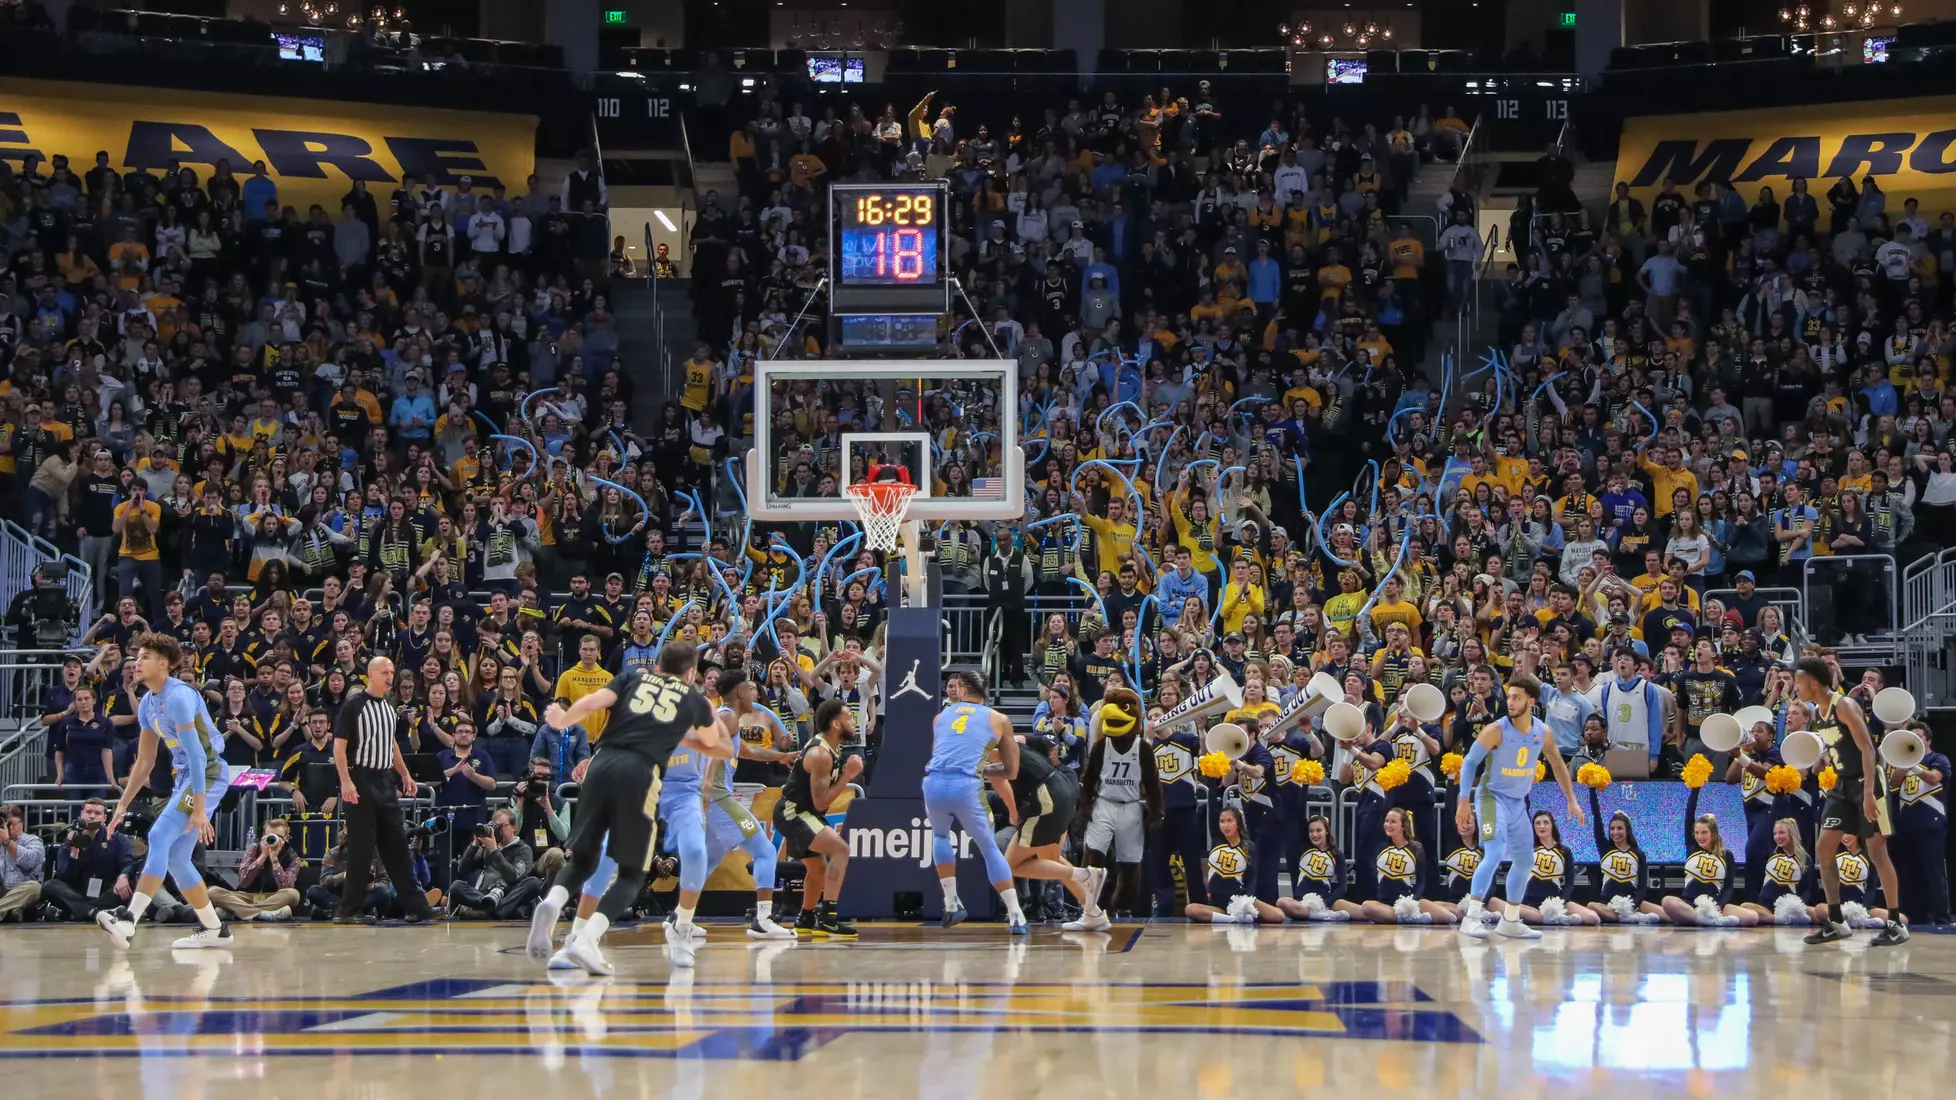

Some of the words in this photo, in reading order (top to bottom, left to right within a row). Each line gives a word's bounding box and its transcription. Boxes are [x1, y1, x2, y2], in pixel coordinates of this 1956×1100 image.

[610, 11, 623, 22] EXIT
[598, 97, 621, 118] 110
[647, 97, 670, 118] 112
[1496, 99, 1520, 119] 112
[1545, 99, 1569, 119] 113
[123, 120, 503, 189] ARE
[856, 195, 933, 226] 16:29
[877, 228, 924, 280] 18
[1051, 299, 1061, 310] 3
[1807, 320, 1821, 331] 33
[691, 372, 704, 383] 33
[467, 550, 476, 563] 3
[628, 682, 683, 723] 55
[1188, 683, 1214, 708] OUT
[1291, 687, 1311, 710] OUT
[951, 714, 969, 734] 4
[1617, 704, 1632, 723] 3
[1157, 752, 1180, 774] MU
[1515, 746, 1529, 767] 0
[1111, 761, 1131, 779] 77
[1105, 778, 1135, 787] MARQUETTE
[1823, 817, 1842, 829] P
[848, 816, 971, 869] meijr
[1216, 850, 1239, 873] MU
[1308, 853, 1328, 875] MU
[1385, 852, 1407, 874] MU
[1458, 852, 1479, 874] MU
[1535, 852, 1556, 874] MU
[1610, 855, 1632, 877] MU
[1695, 855, 1718, 878] MU
[1773, 857, 1796, 881] MU
[1840, 857, 1862, 880] MU
